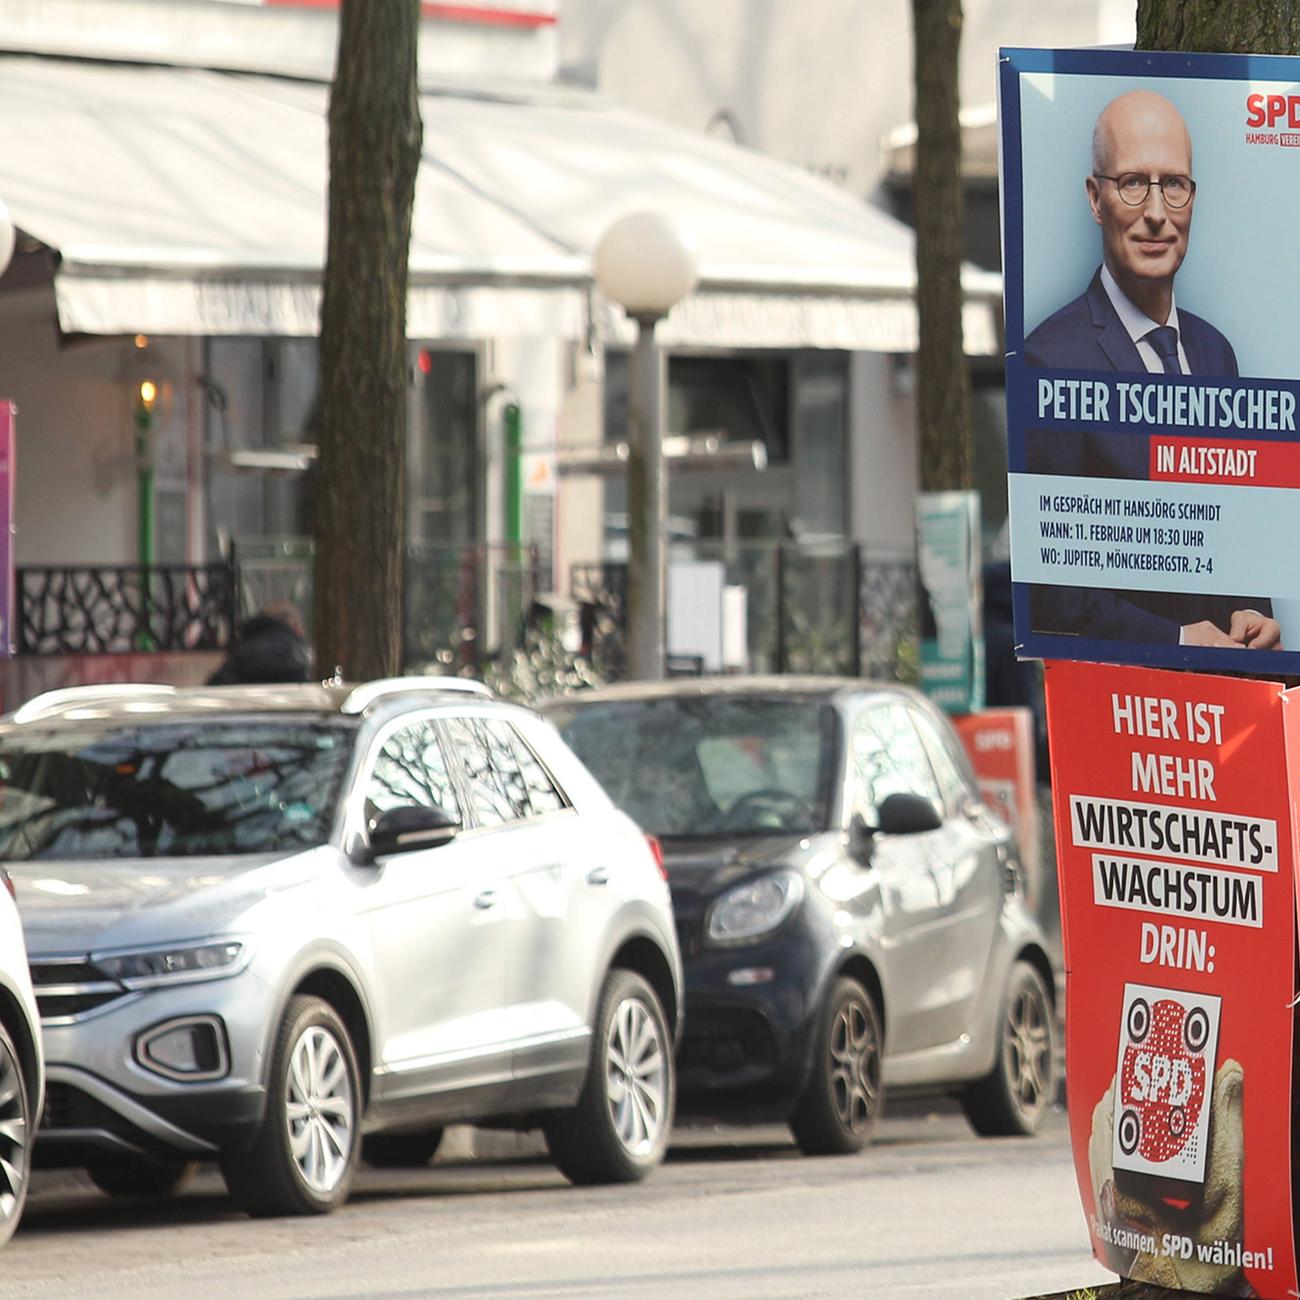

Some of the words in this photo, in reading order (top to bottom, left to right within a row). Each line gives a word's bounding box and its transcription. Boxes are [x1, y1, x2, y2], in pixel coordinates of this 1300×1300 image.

[1246, 133, 1279, 145] HAMBURG
[1037, 379, 1110, 422] PETER
[1116, 384, 1296, 431] TSCHENTSCHER
[1156, 445, 1176, 473] IN
[1179, 447, 1257, 477] ALTSTADT
[1039, 495, 1051, 512] IM
[1053, 494, 1101, 514] GESPRÄCH
[1105, 499, 1121, 516] MIT
[1124, 498, 1176, 519] HANSJÖRG
[1178, 503, 1221, 522] SCHMIDT
[1040, 521, 1073, 540] WANN:
[1075, 523, 1087, 540] 11.
[1090, 525, 1133, 543] FEBRUAR
[1136, 527, 1151, 544] UM
[1153, 528, 1180, 546] 18:30
[1183, 530, 1204, 547] UHR
[1040, 547, 1061, 565] WO:
[1063, 549, 1104, 570] JUPITER,
[1106, 549, 1192, 573] MÖNCKEBERGSTR.
[1195, 557, 1213, 574] 2-4
[1111, 693, 1179, 739] HIER
[1185, 701, 1224, 745] IST
[1131, 751, 1217, 801] MEHR
[1075, 801, 1273, 864] WIRTSCHAFTS-
[1099, 860, 1257, 921] WACHSTUM
[1139, 922, 1216, 973] DRIN:
[1131, 1052, 1194, 1106] SPD
[1113, 1228, 1159, 1258] scannen,
[1162, 1233, 1193, 1260] SPD
[1197, 1239, 1274, 1271] wählen!
